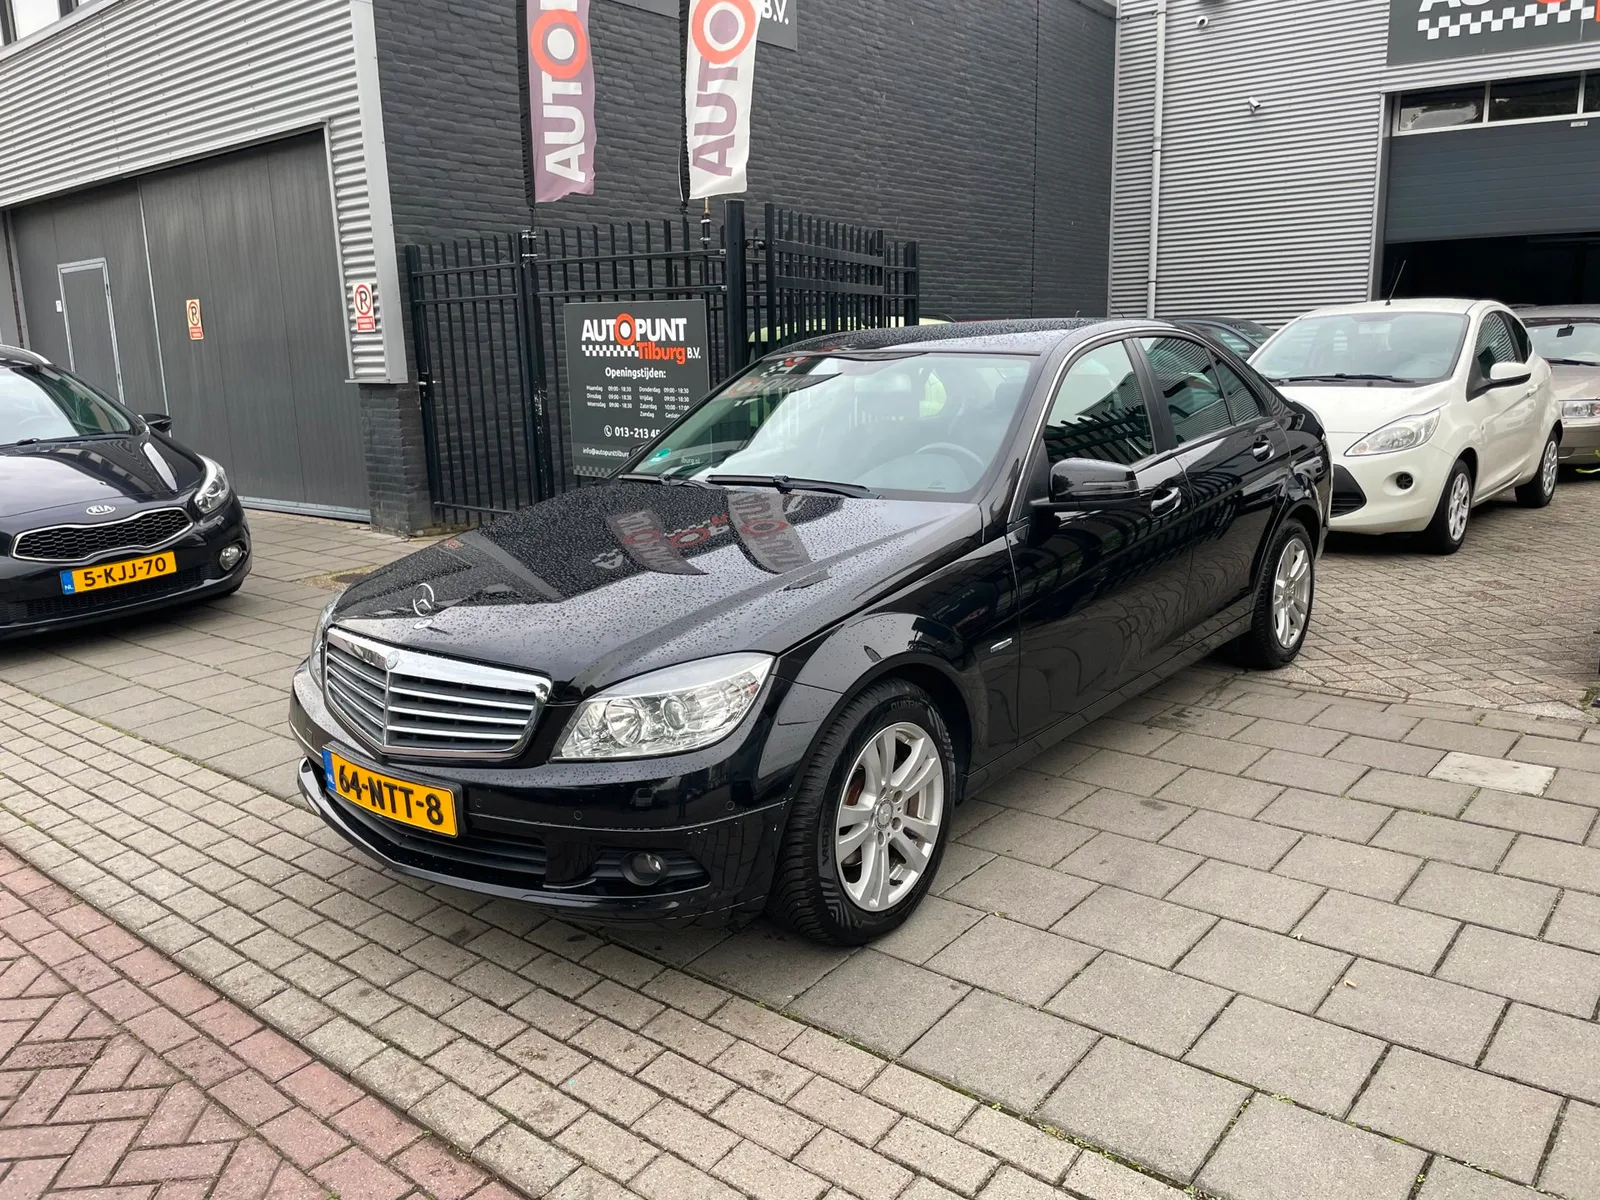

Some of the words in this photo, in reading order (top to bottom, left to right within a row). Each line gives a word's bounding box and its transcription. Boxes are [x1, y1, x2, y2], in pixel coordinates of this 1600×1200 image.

[691, 0, 757, 177] AUTO
[581, 313, 687, 346] AUTOPUNT
[636, 342, 686, 364] Tilburg
[687, 347, 701, 359] B.V.
[605, 367, 667, 380] Openingstijden:
[89, 505, 112, 513] KIA
[83, 557, 166, 587] 5-KJJ-70
[338, 765, 444, 826] 64-NTT-8
